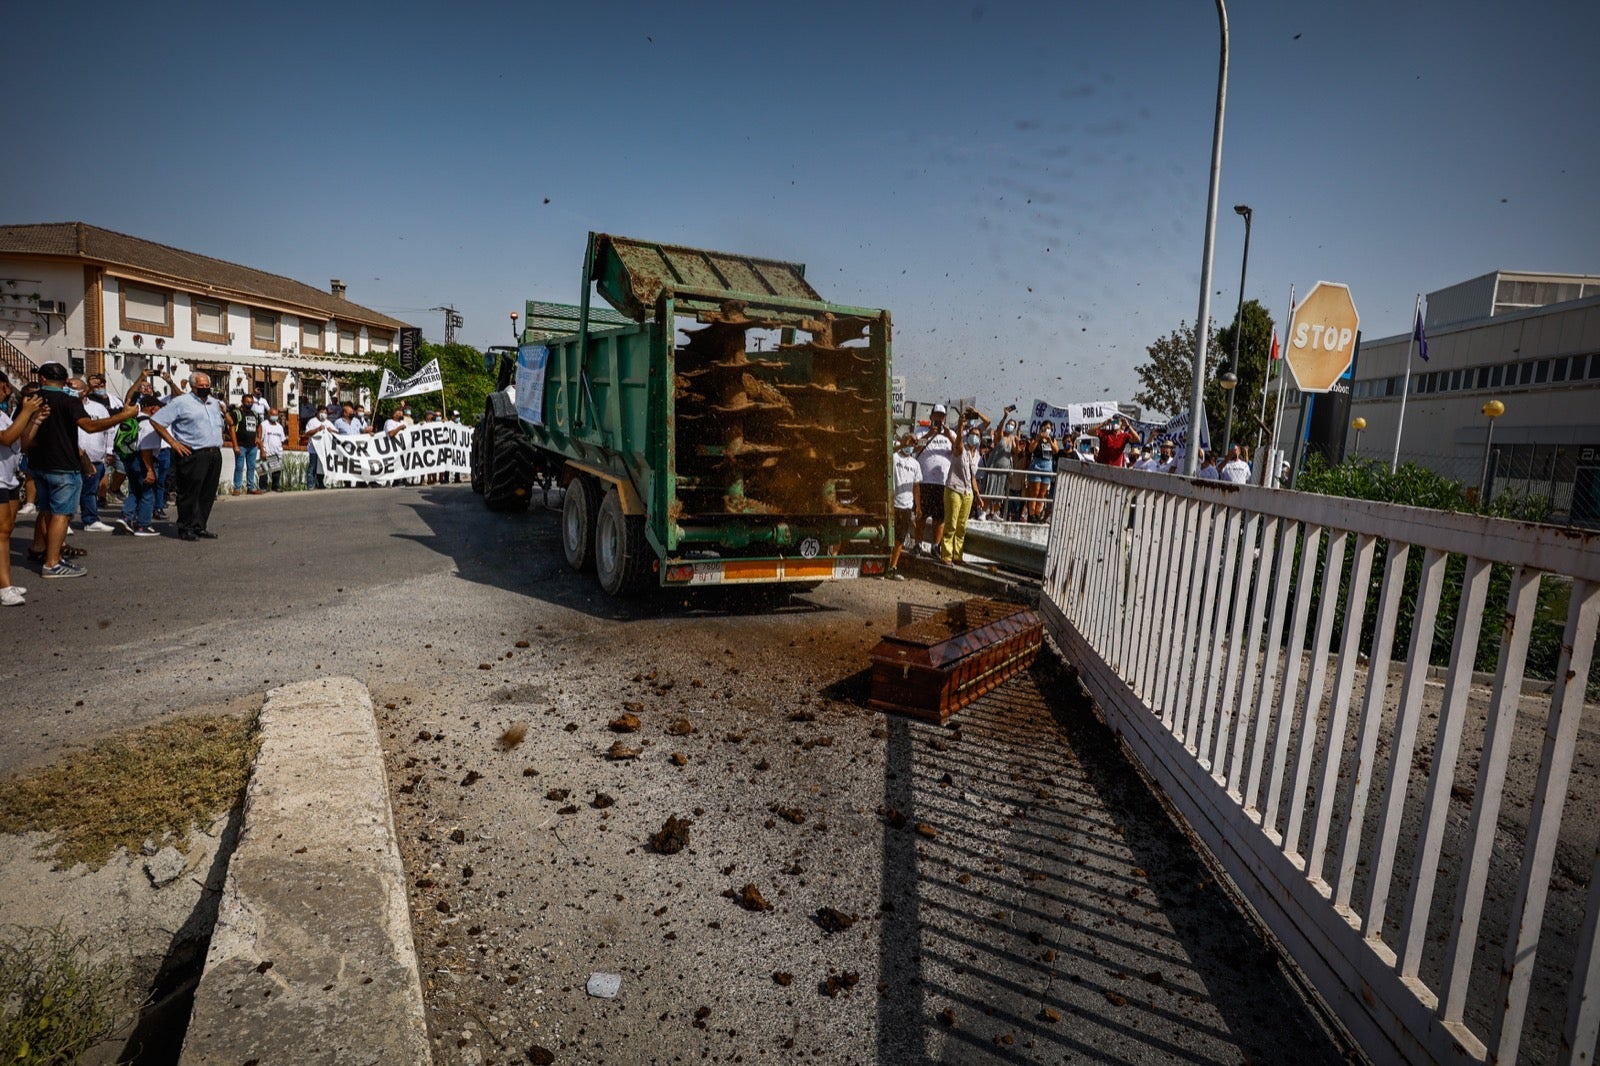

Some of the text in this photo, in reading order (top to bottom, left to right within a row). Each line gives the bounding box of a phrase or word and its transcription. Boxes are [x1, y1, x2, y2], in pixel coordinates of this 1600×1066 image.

[1293, 322, 1352, 352] STOP
[892, 393, 903, 402] TOR
[1082, 407, 1094, 419] POR
[1095, 406, 1103, 417] LA
[331, 435, 370, 457] POR
[374, 434, 406, 456] UN
[410, 426, 457, 448] PRECIO
[326, 453, 362, 476] CHE
[368, 456, 394, 476] DE
[399, 447, 447, 471] VACA
[443, 447, 466, 468] PARA
[803, 541, 817, 557] 25
